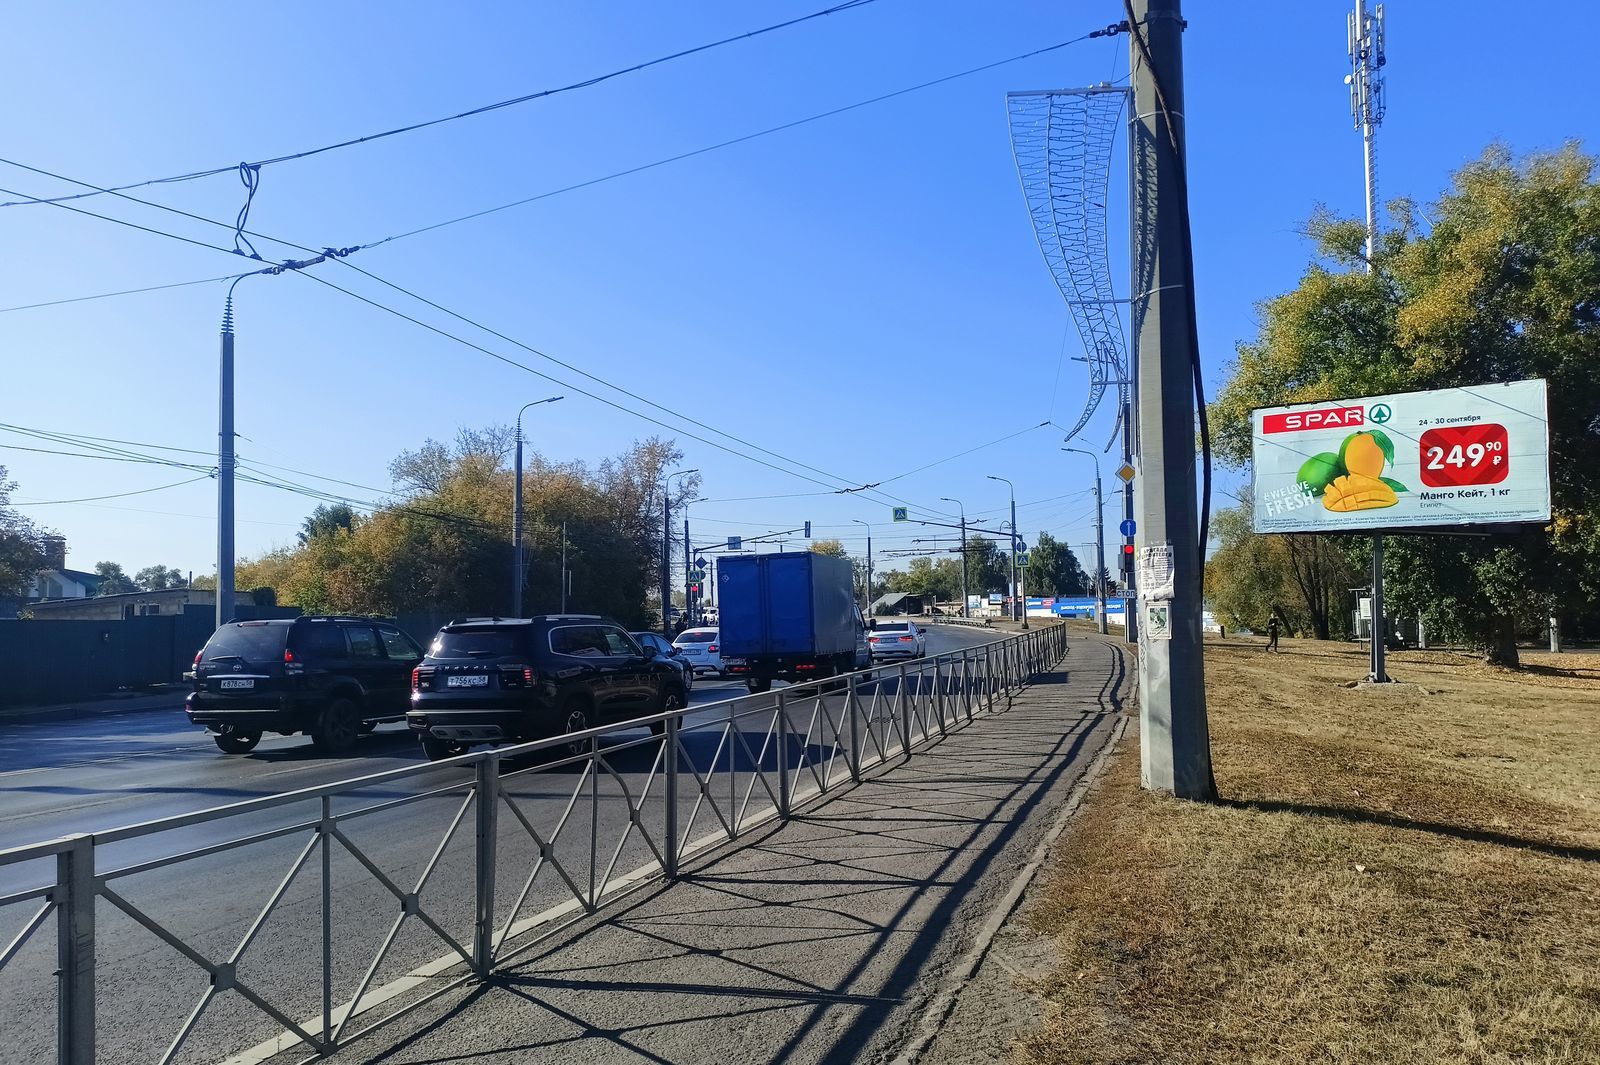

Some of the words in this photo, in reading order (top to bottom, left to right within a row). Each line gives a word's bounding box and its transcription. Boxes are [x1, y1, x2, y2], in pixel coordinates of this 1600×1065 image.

[1285, 409, 1362, 429] SPAR
[1435, 417, 1445, 425] 30
[1446, 415, 1481, 424] сентября
[1427, 443, 1485, 470] 249
[1486, 441, 1502, 451] 90
[1265, 490, 1316, 517] FRESH
[1420, 491, 1455, 500] Манго
[1457, 489, 1487, 498] Кейт,
